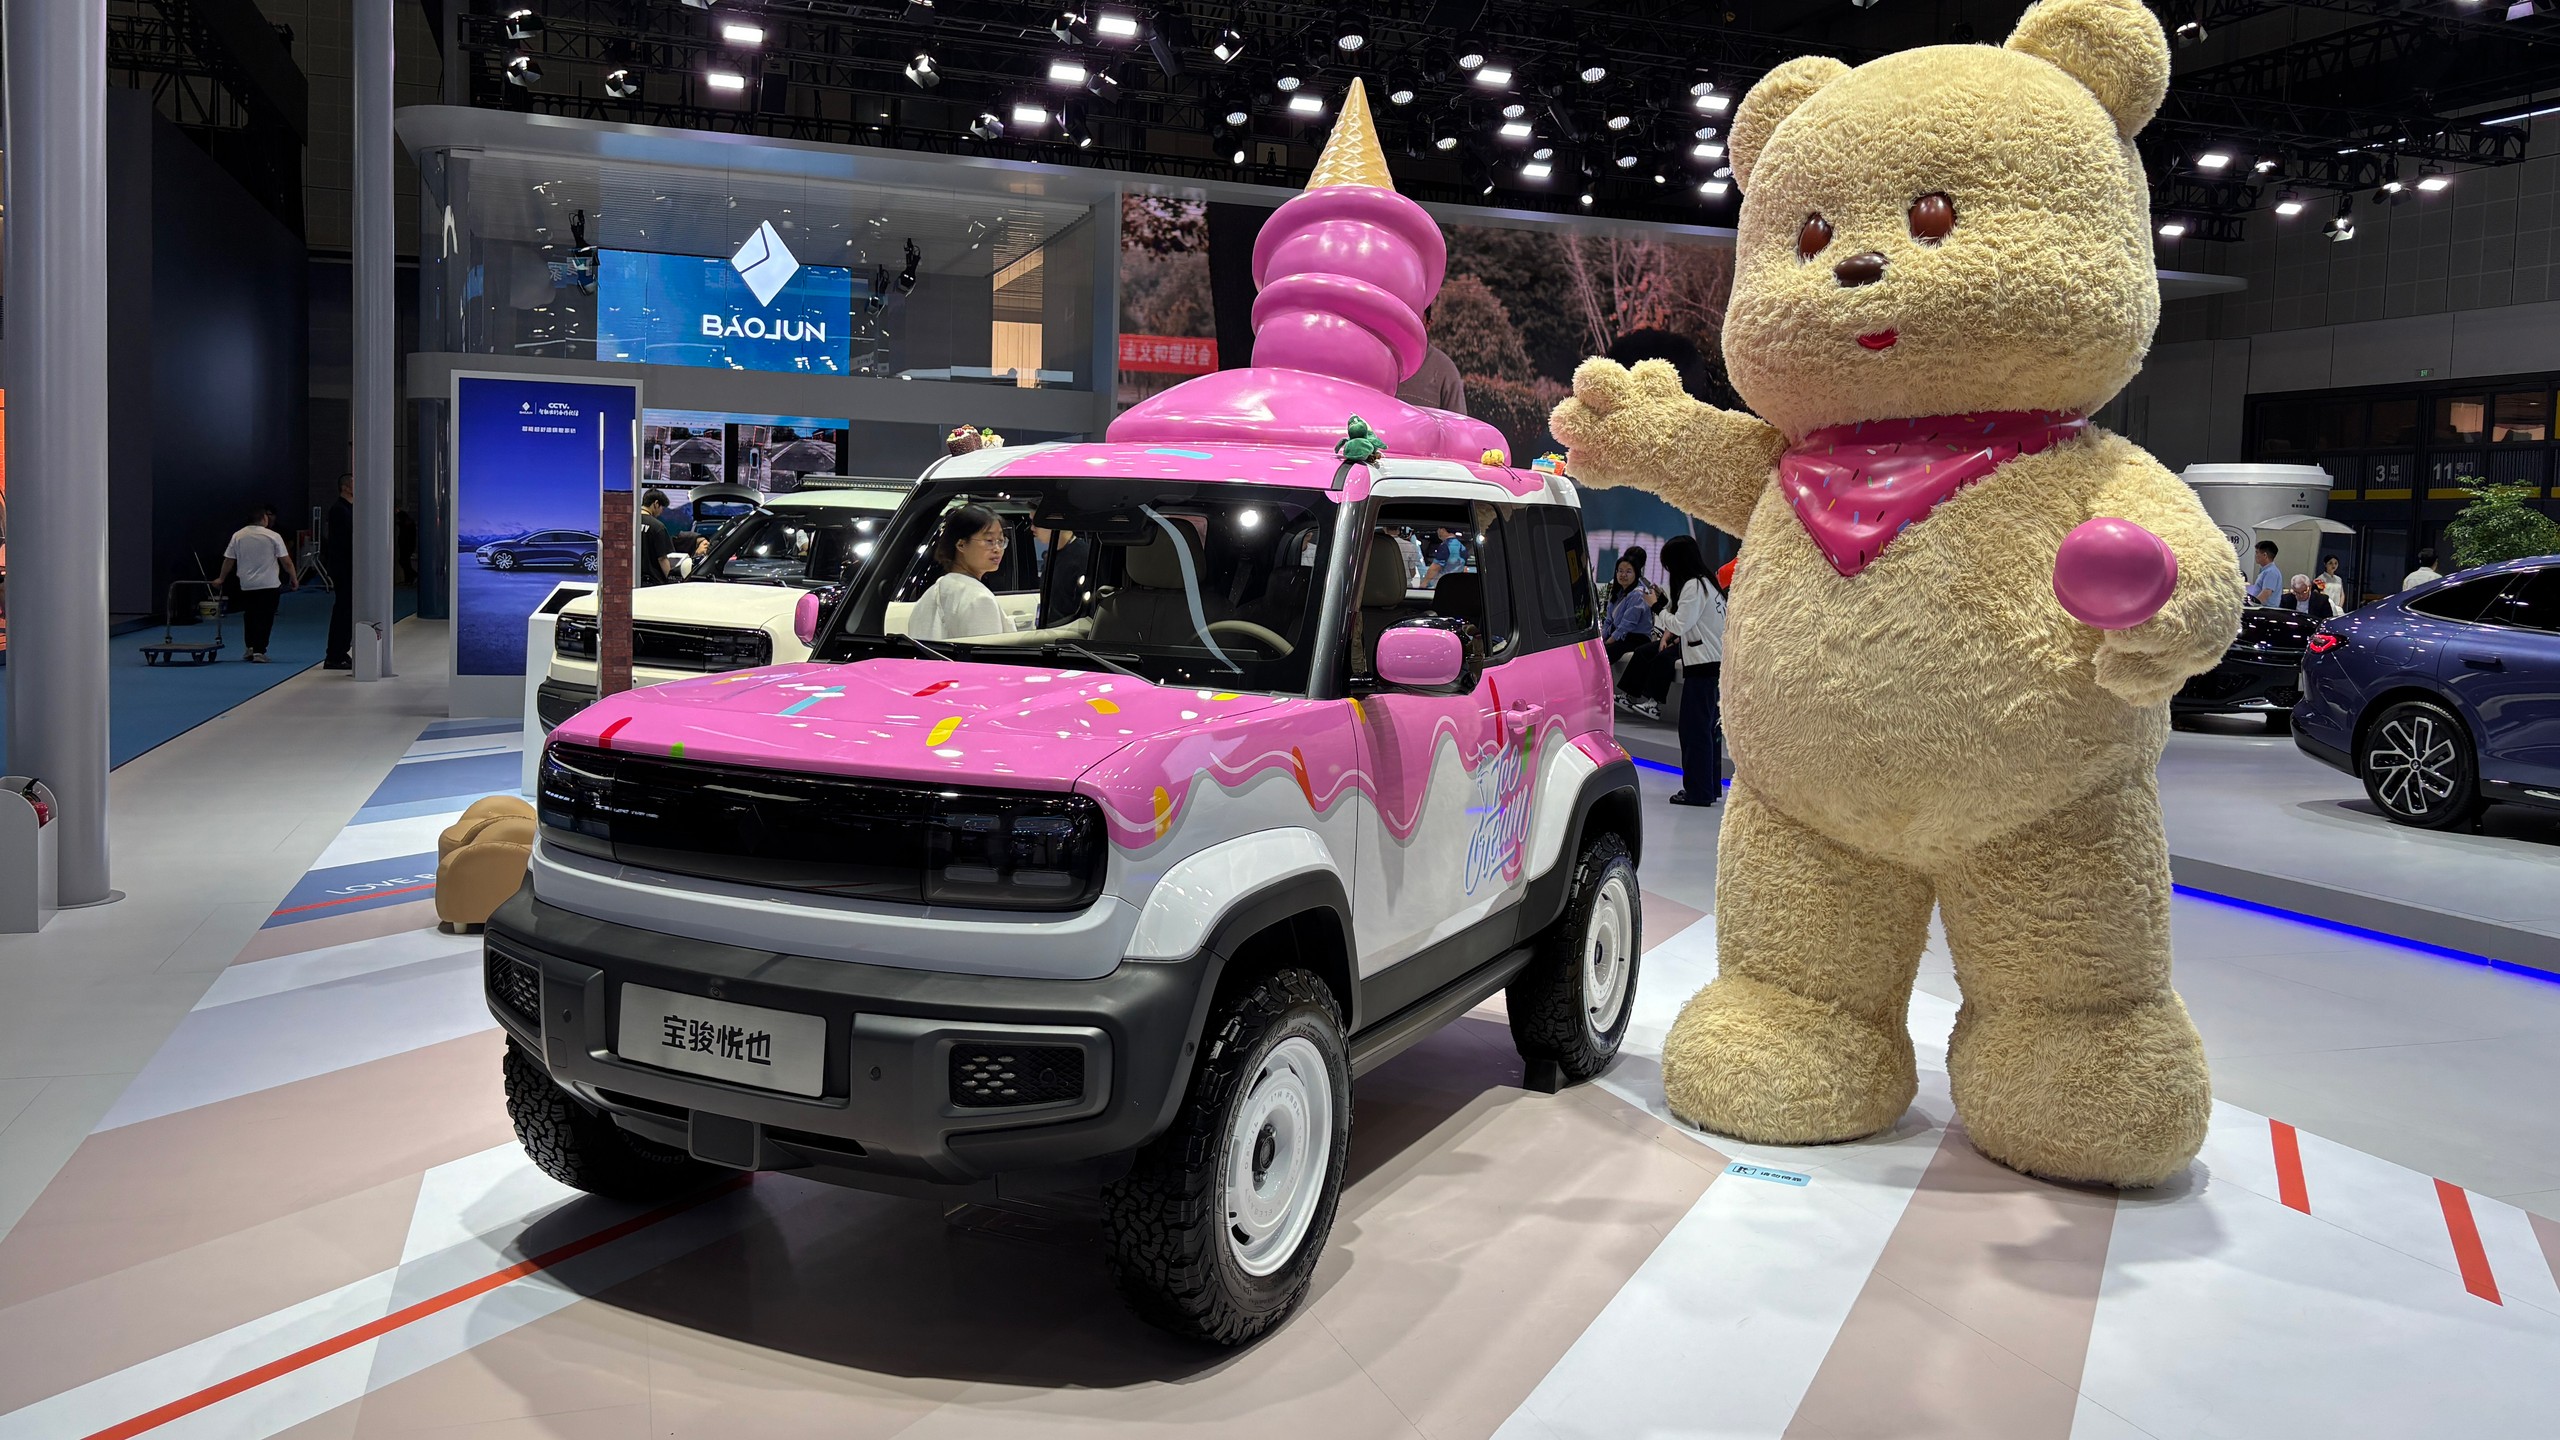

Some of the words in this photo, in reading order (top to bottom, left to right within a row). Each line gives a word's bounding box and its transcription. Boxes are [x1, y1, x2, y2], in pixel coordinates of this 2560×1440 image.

[702, 314, 826, 343] BAOJUN
[2375, 464, 2386, 482] 3
[2433, 462, 2452, 480] 11
[1490, 739, 1523, 809] Ice
[325, 877, 420, 895] LOVE
[661, 1014, 772, 1066] 宝骏悦也
